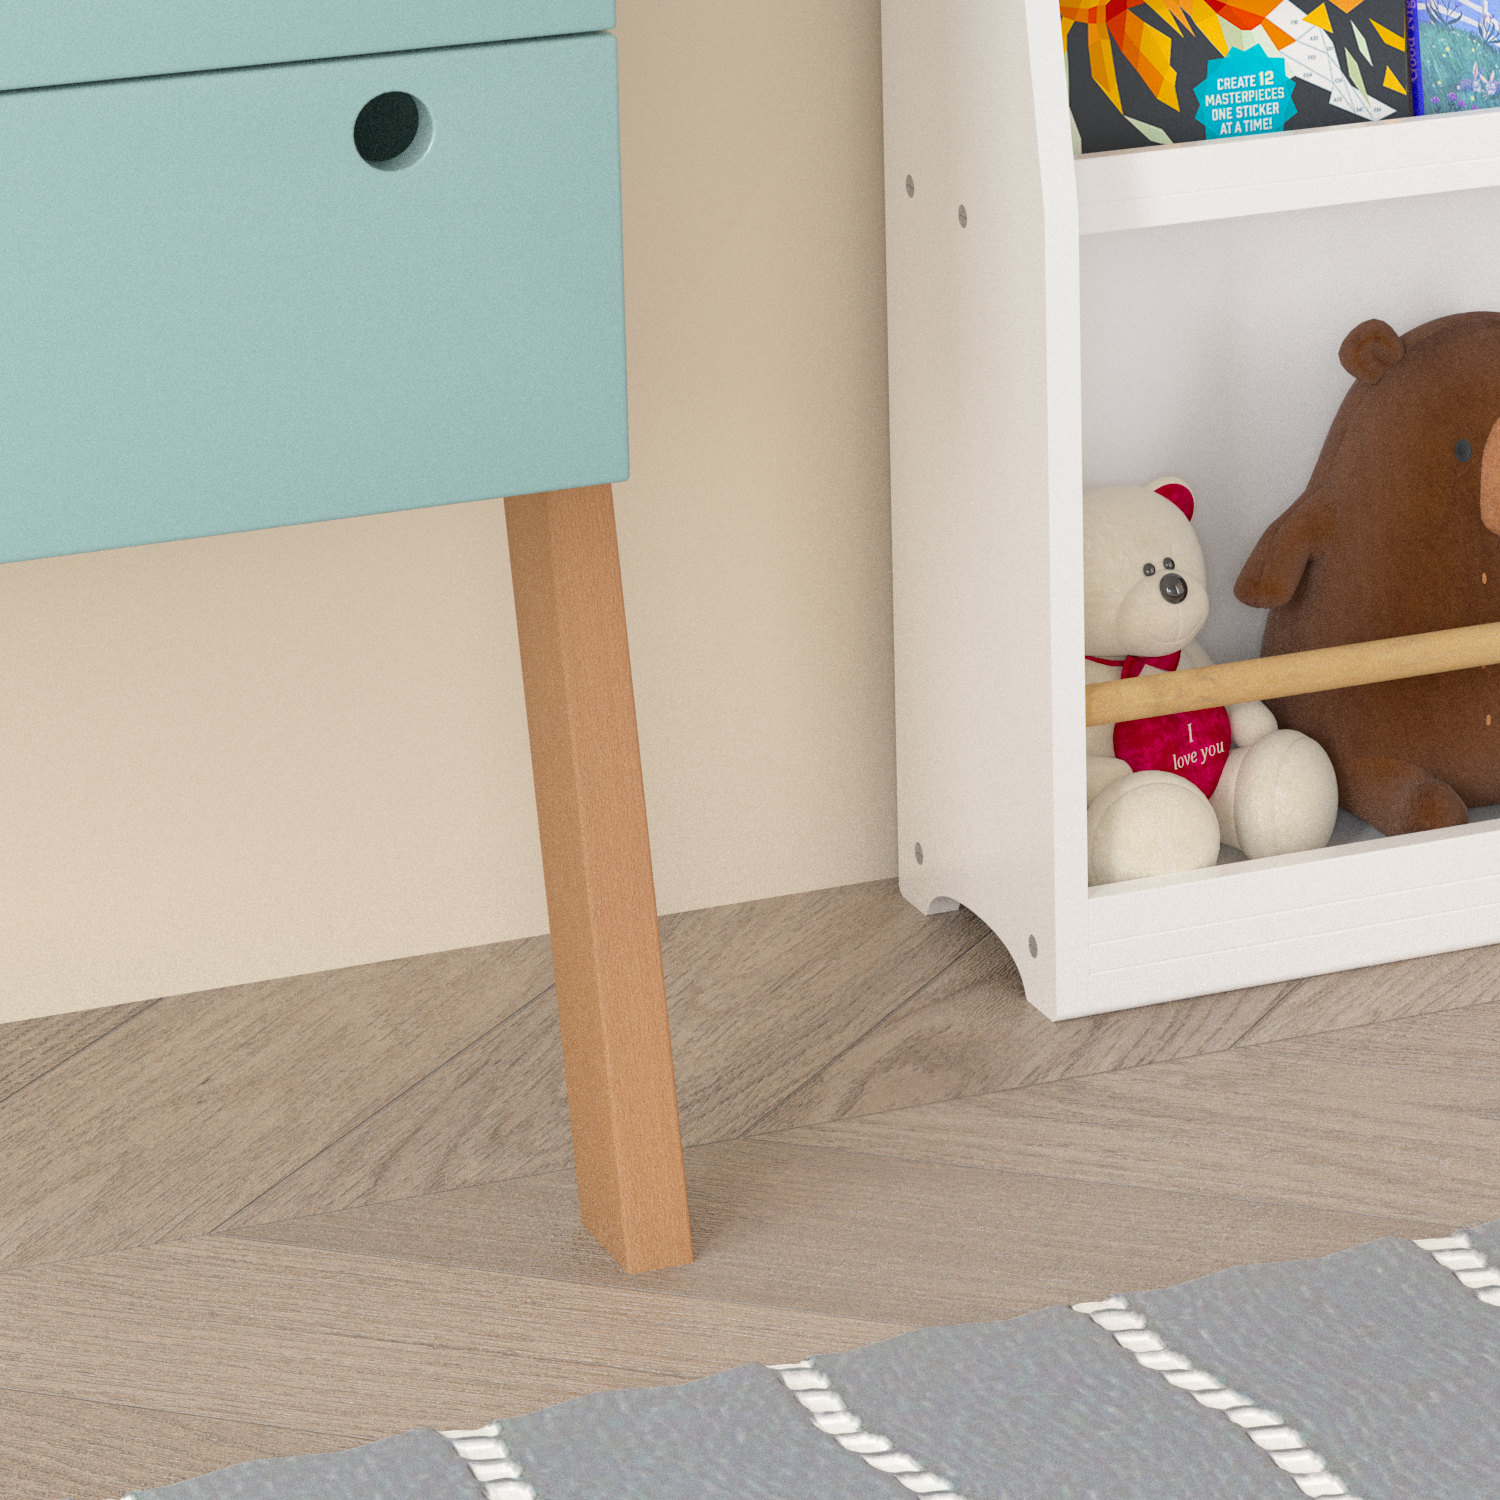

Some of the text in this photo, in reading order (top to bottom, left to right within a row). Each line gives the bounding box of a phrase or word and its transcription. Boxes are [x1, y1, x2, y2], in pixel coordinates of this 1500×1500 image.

[1216, 70, 1274, 91] CREATE 12
[1205, 86, 1285, 107] MASTERPIECES
[1211, 102, 1280, 121] ONE STICKER
[1220, 117, 1273, 135] AT A TIME!
[1186, 722, 1195, 744] I
[1172, 741, 1225, 770] love you
